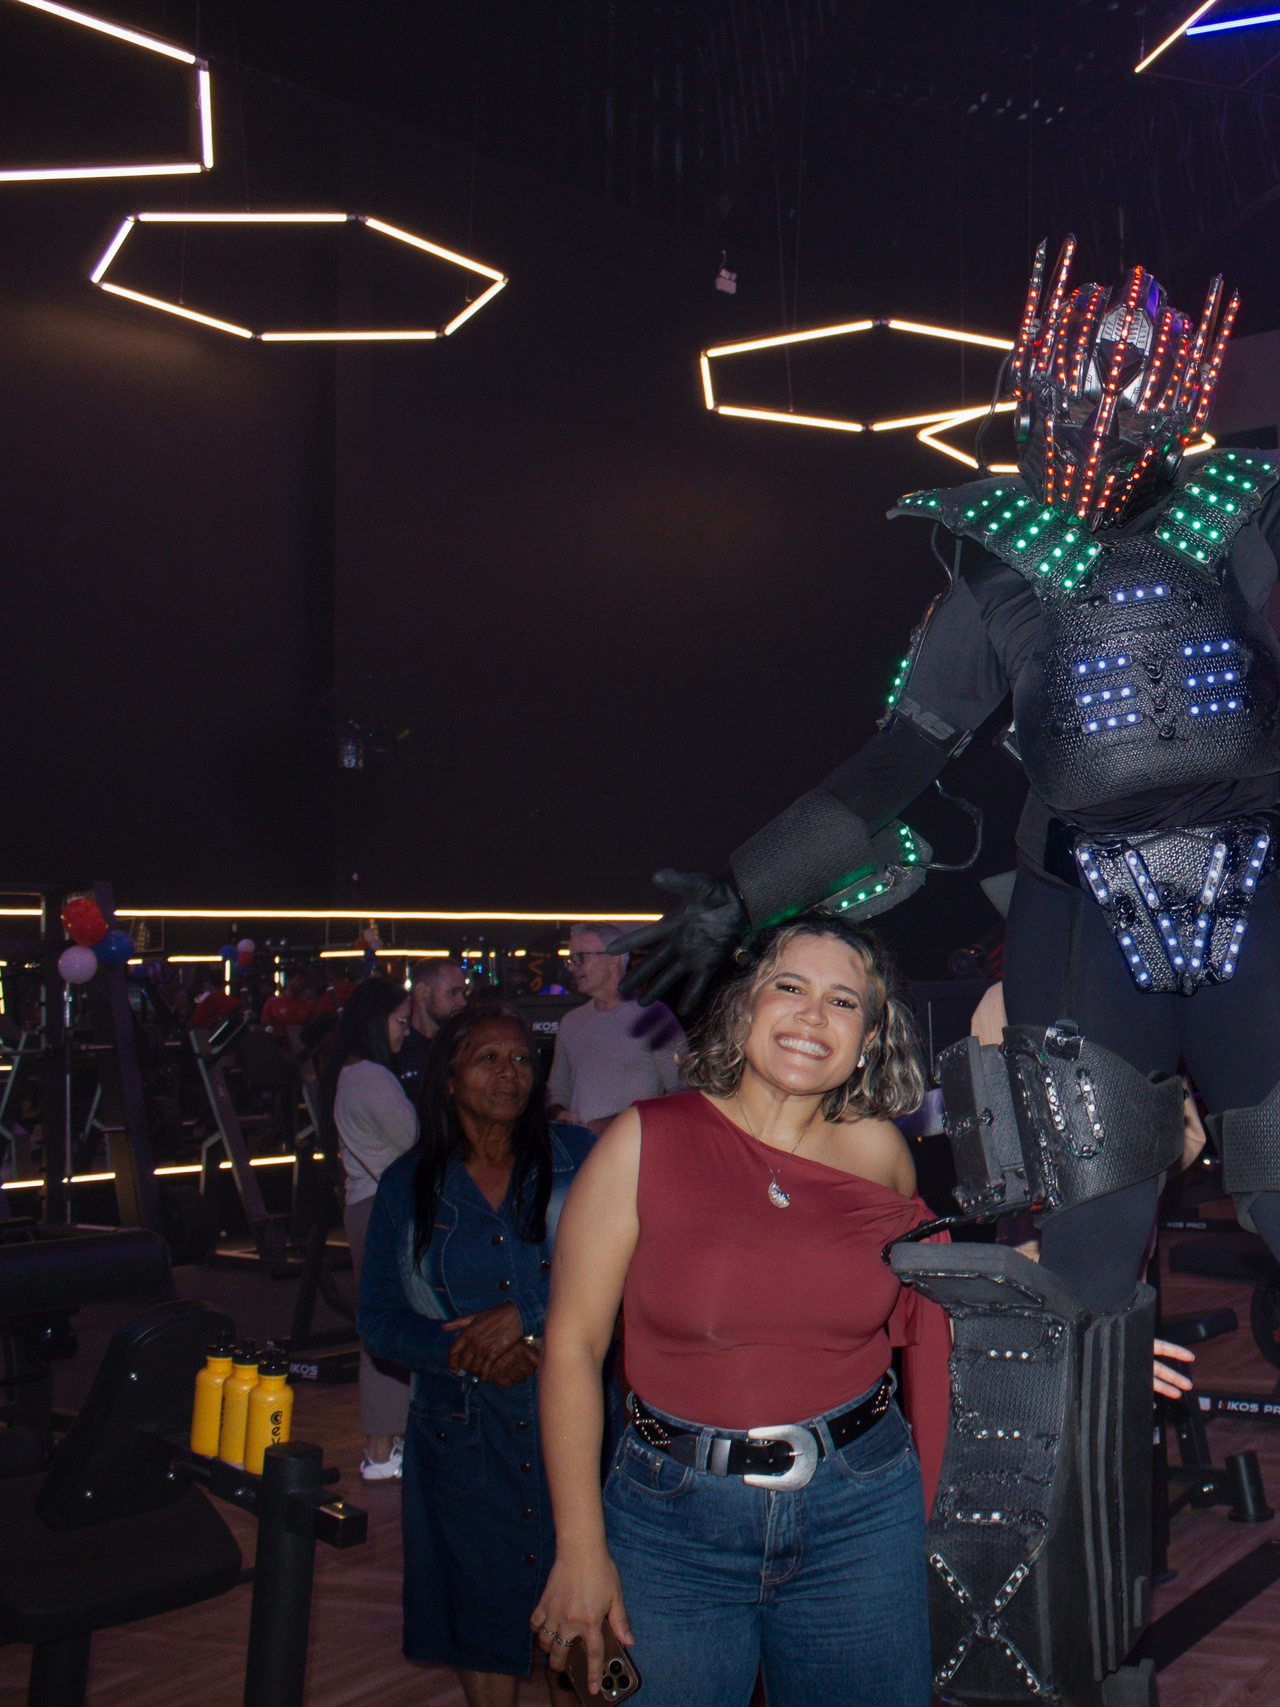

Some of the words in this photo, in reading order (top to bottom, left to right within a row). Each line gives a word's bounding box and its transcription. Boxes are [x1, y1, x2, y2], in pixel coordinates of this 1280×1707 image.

[532, 1021, 559, 1031] IKOS
[288, 1363, 318, 1376] IKOS
[1218, 1400, 1259, 1413] KIKOS
